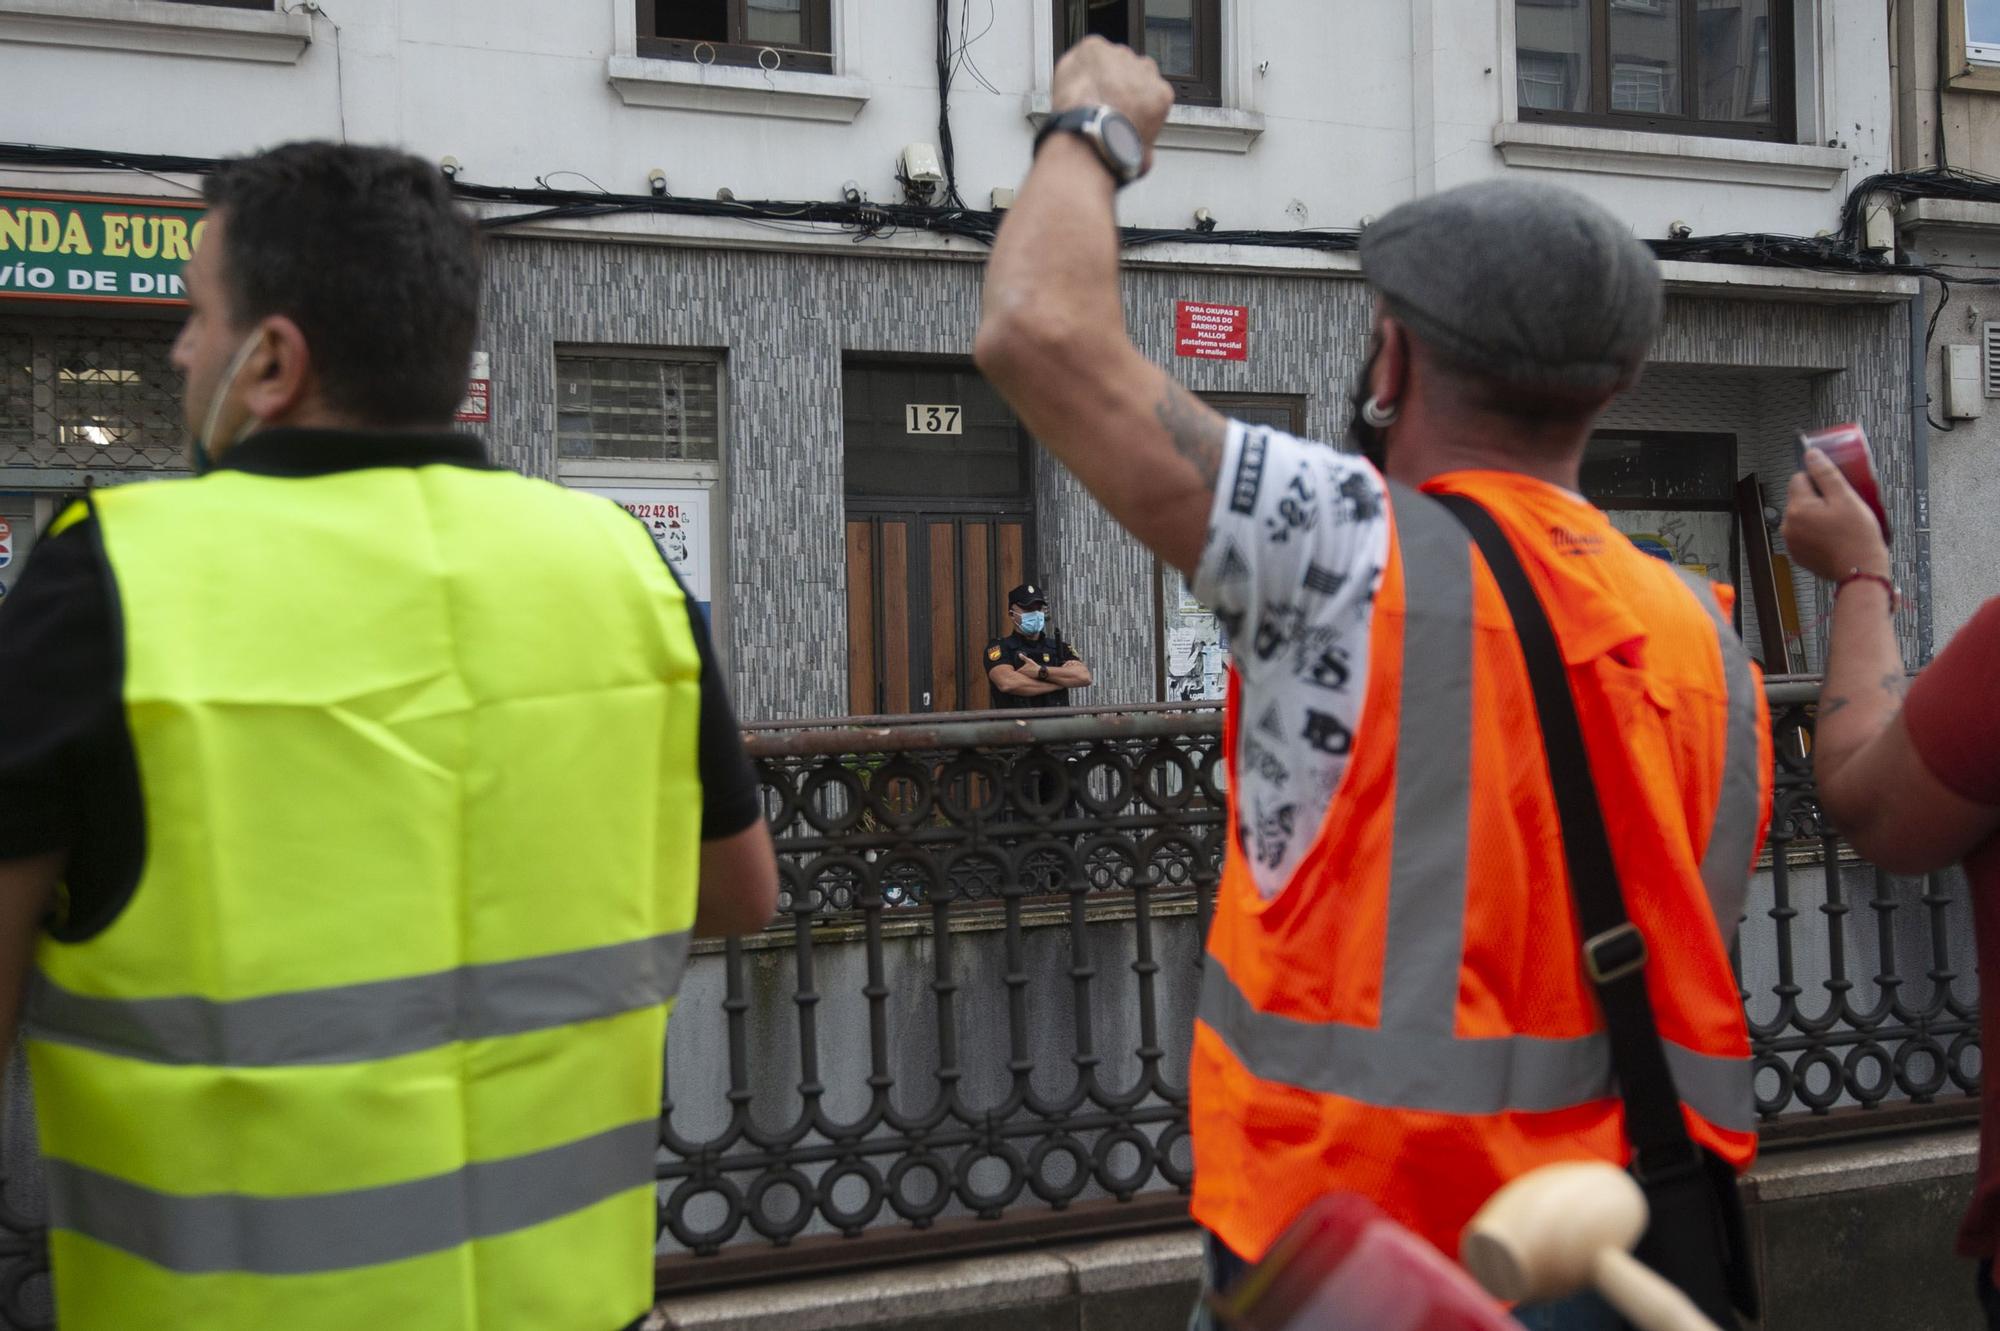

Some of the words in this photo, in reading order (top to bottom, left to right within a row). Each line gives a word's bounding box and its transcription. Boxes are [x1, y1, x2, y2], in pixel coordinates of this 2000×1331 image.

[68, 269, 118, 292] DE
[1206, 308, 1234, 316] OKUPAS
[1192, 315, 1220, 323] DROGAS
[1182, 338, 1217, 347] plataforma
[911, 406, 959, 432] 137
[638, 504, 651, 518] 22
[653, 504, 665, 518] 42
[667, 504, 679, 519] 81
